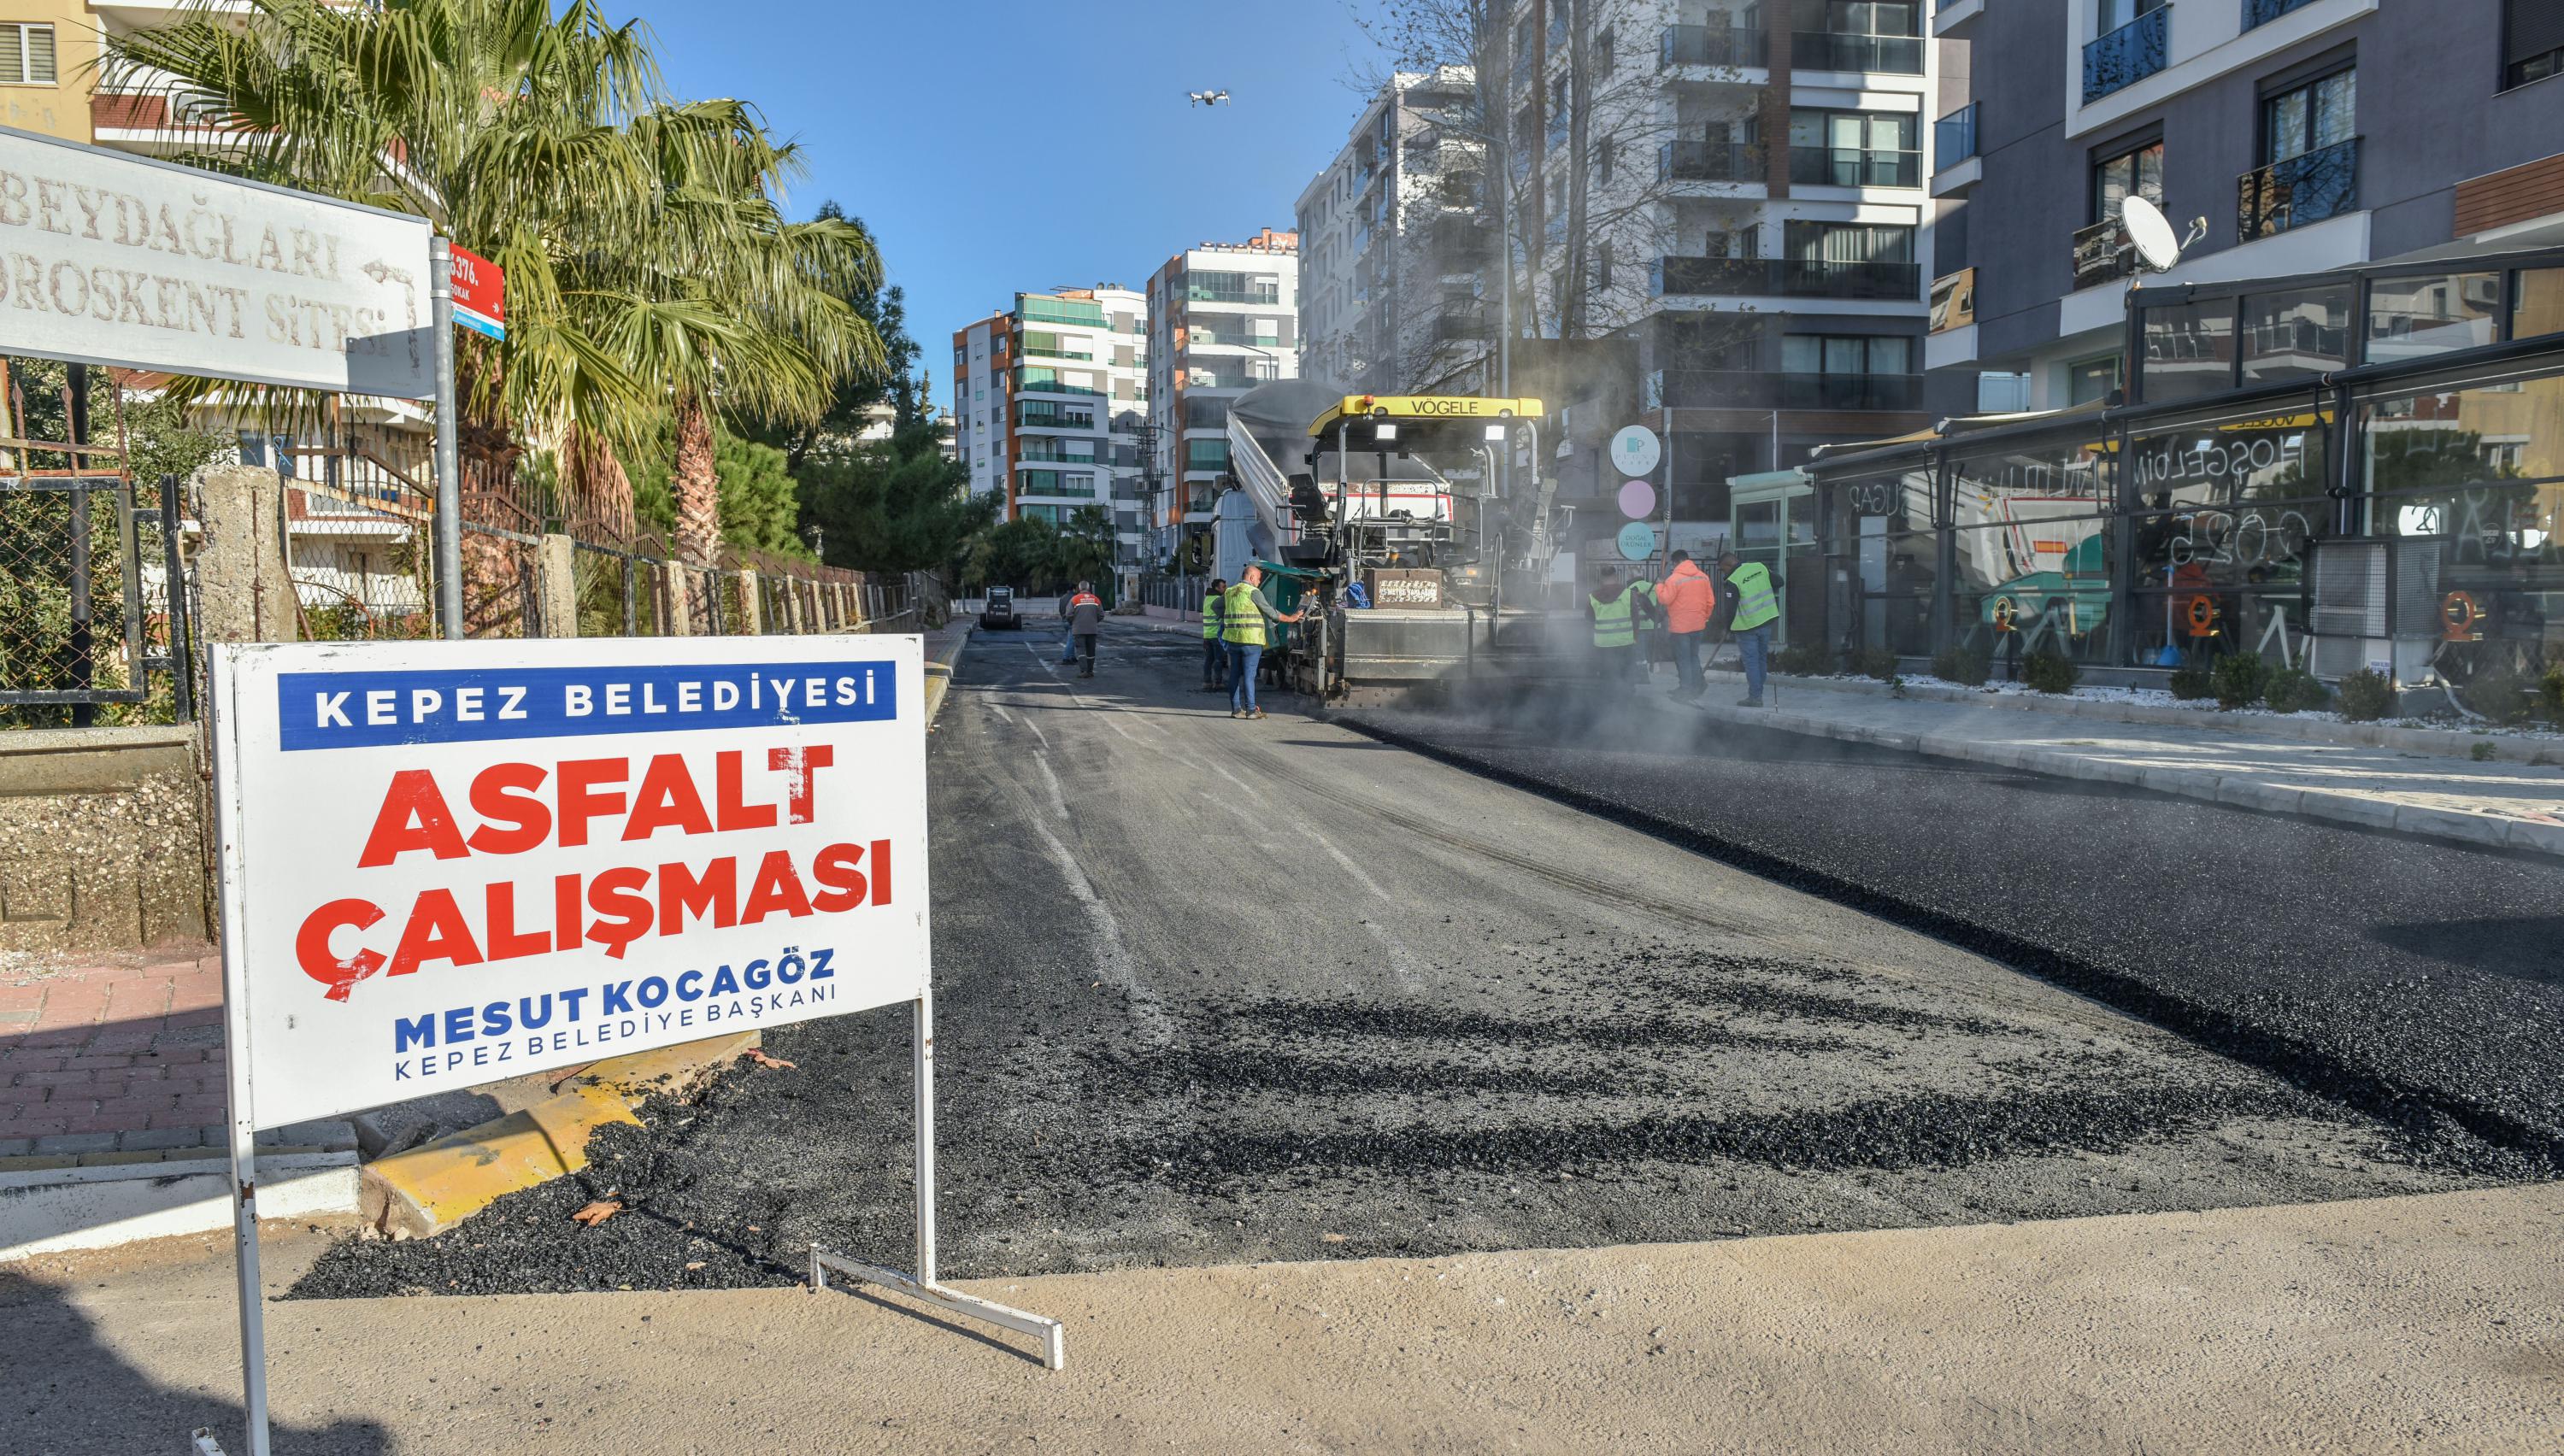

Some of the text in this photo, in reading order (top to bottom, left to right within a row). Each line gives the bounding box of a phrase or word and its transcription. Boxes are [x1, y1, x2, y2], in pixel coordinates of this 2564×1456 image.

[0, 251, 250, 339] ROSKENT
[1411, 398, 1479, 414] VÖGELE
[315, 669, 876, 728] KEPEZ BELEDİYESİ
[357, 744, 834, 868] ASFALT
[295, 839, 892, 1003] ÇALIŞMASI
[395, 946, 836, 1054] MESUT KOCAGÖZ
[396, 983, 837, 1082] KEPEZ BELEDİYE BAŞKANI
